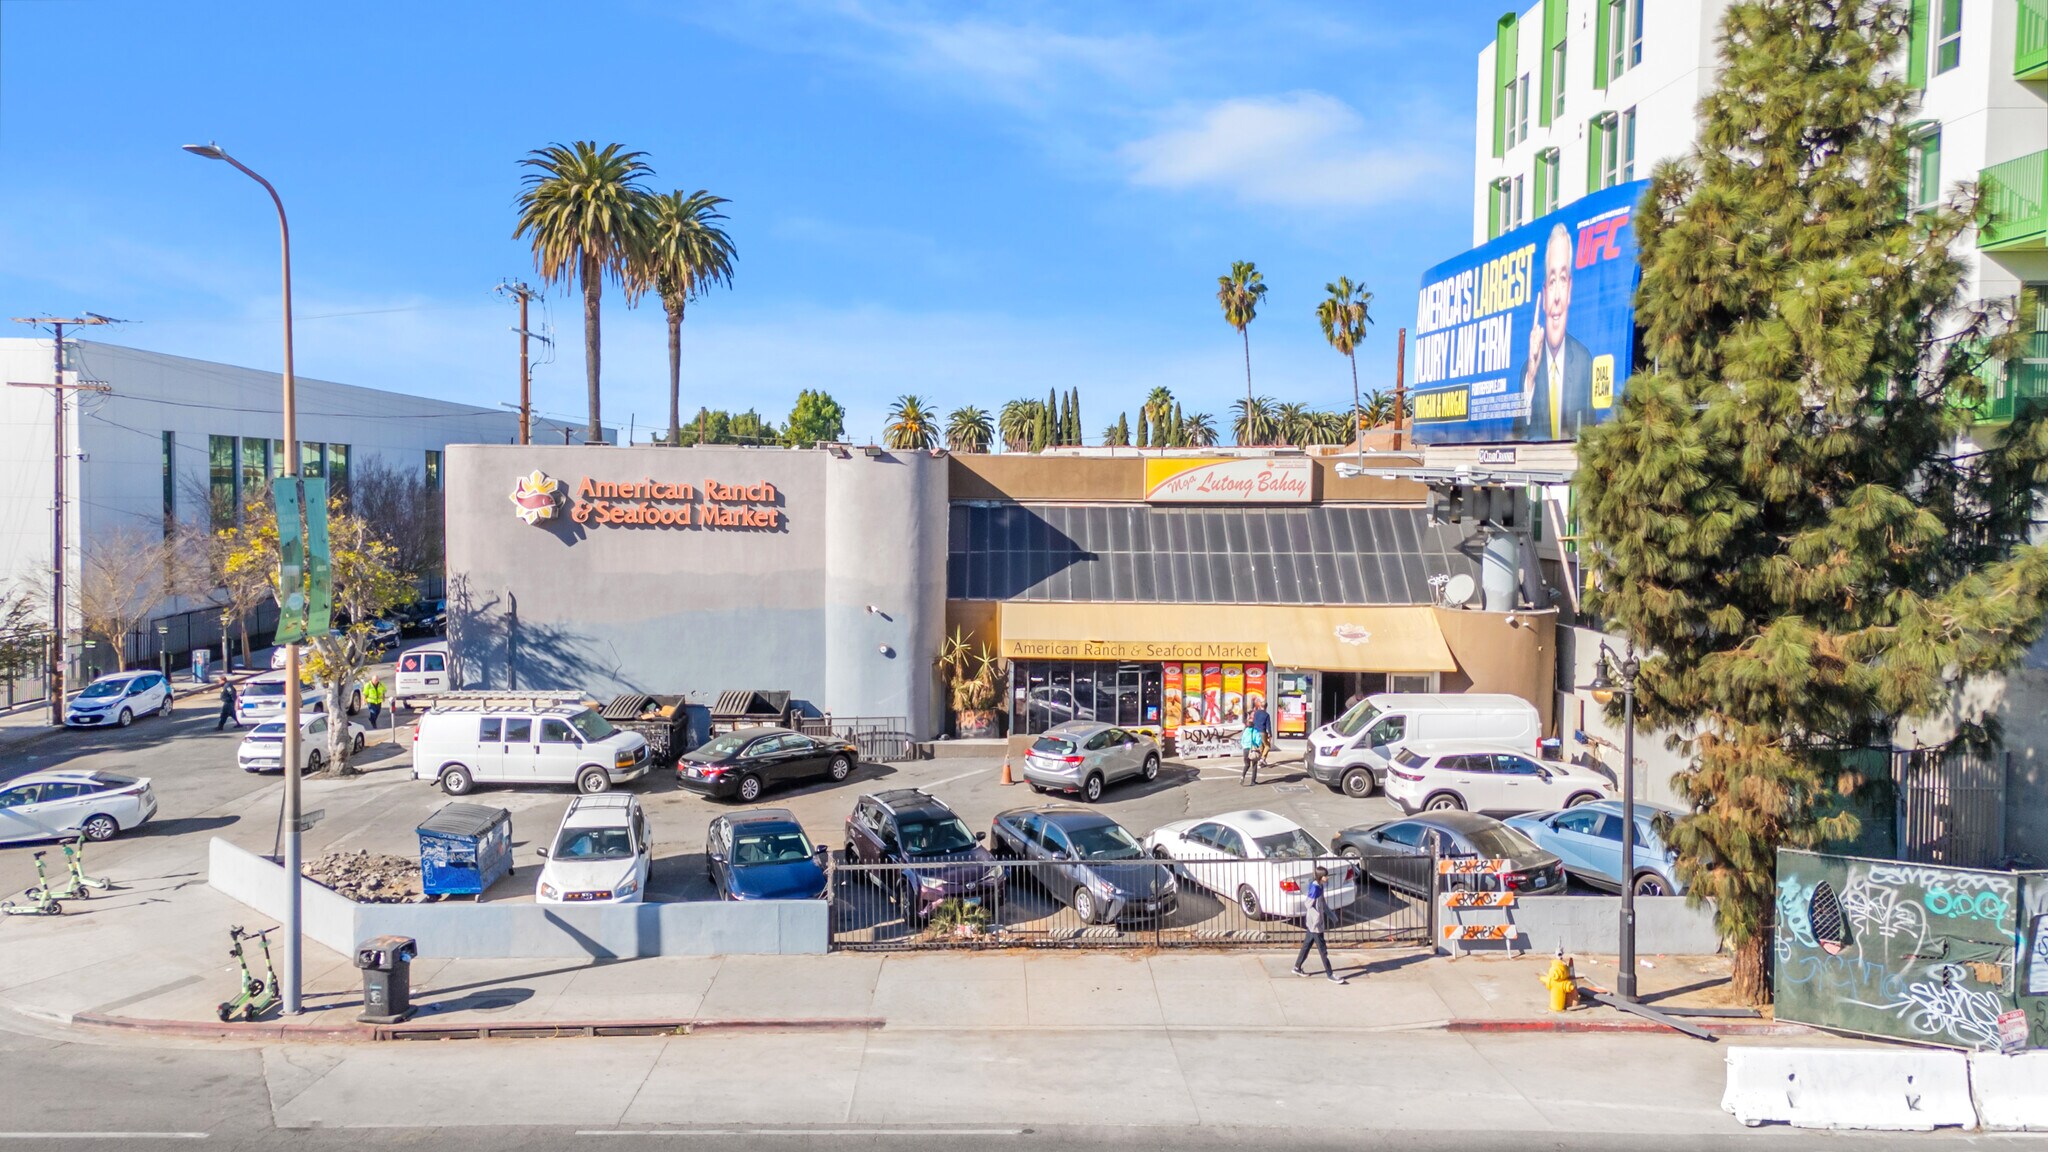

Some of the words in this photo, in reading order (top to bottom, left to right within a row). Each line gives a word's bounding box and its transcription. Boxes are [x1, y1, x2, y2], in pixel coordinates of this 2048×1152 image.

[1576, 214, 1630, 269] UFC
[1416, 269, 1473, 335] AMERICA'S
[1473, 243, 1536, 319] LARGEST
[1450, 322, 1477, 378] LAW
[1477, 313, 1512, 374] FIRM
[576, 475, 693, 500] American
[703, 478, 776, 502] Ranch
[1167, 475, 1198, 494] Mga
[1196, 471, 1254, 498] Lutong
[1257, 471, 1307, 498] Bahay
[572, 501, 593, 524] &
[595, 501, 692, 525] Seafood
[698, 504, 778, 528] Market
[1013, 641, 1078, 655] American
[1084, 642, 1125, 656] Ranch
[1130, 645, 1141, 657] &
[1146, 643, 1202, 657] Seafood
[1207, 645, 1258, 658] Market
